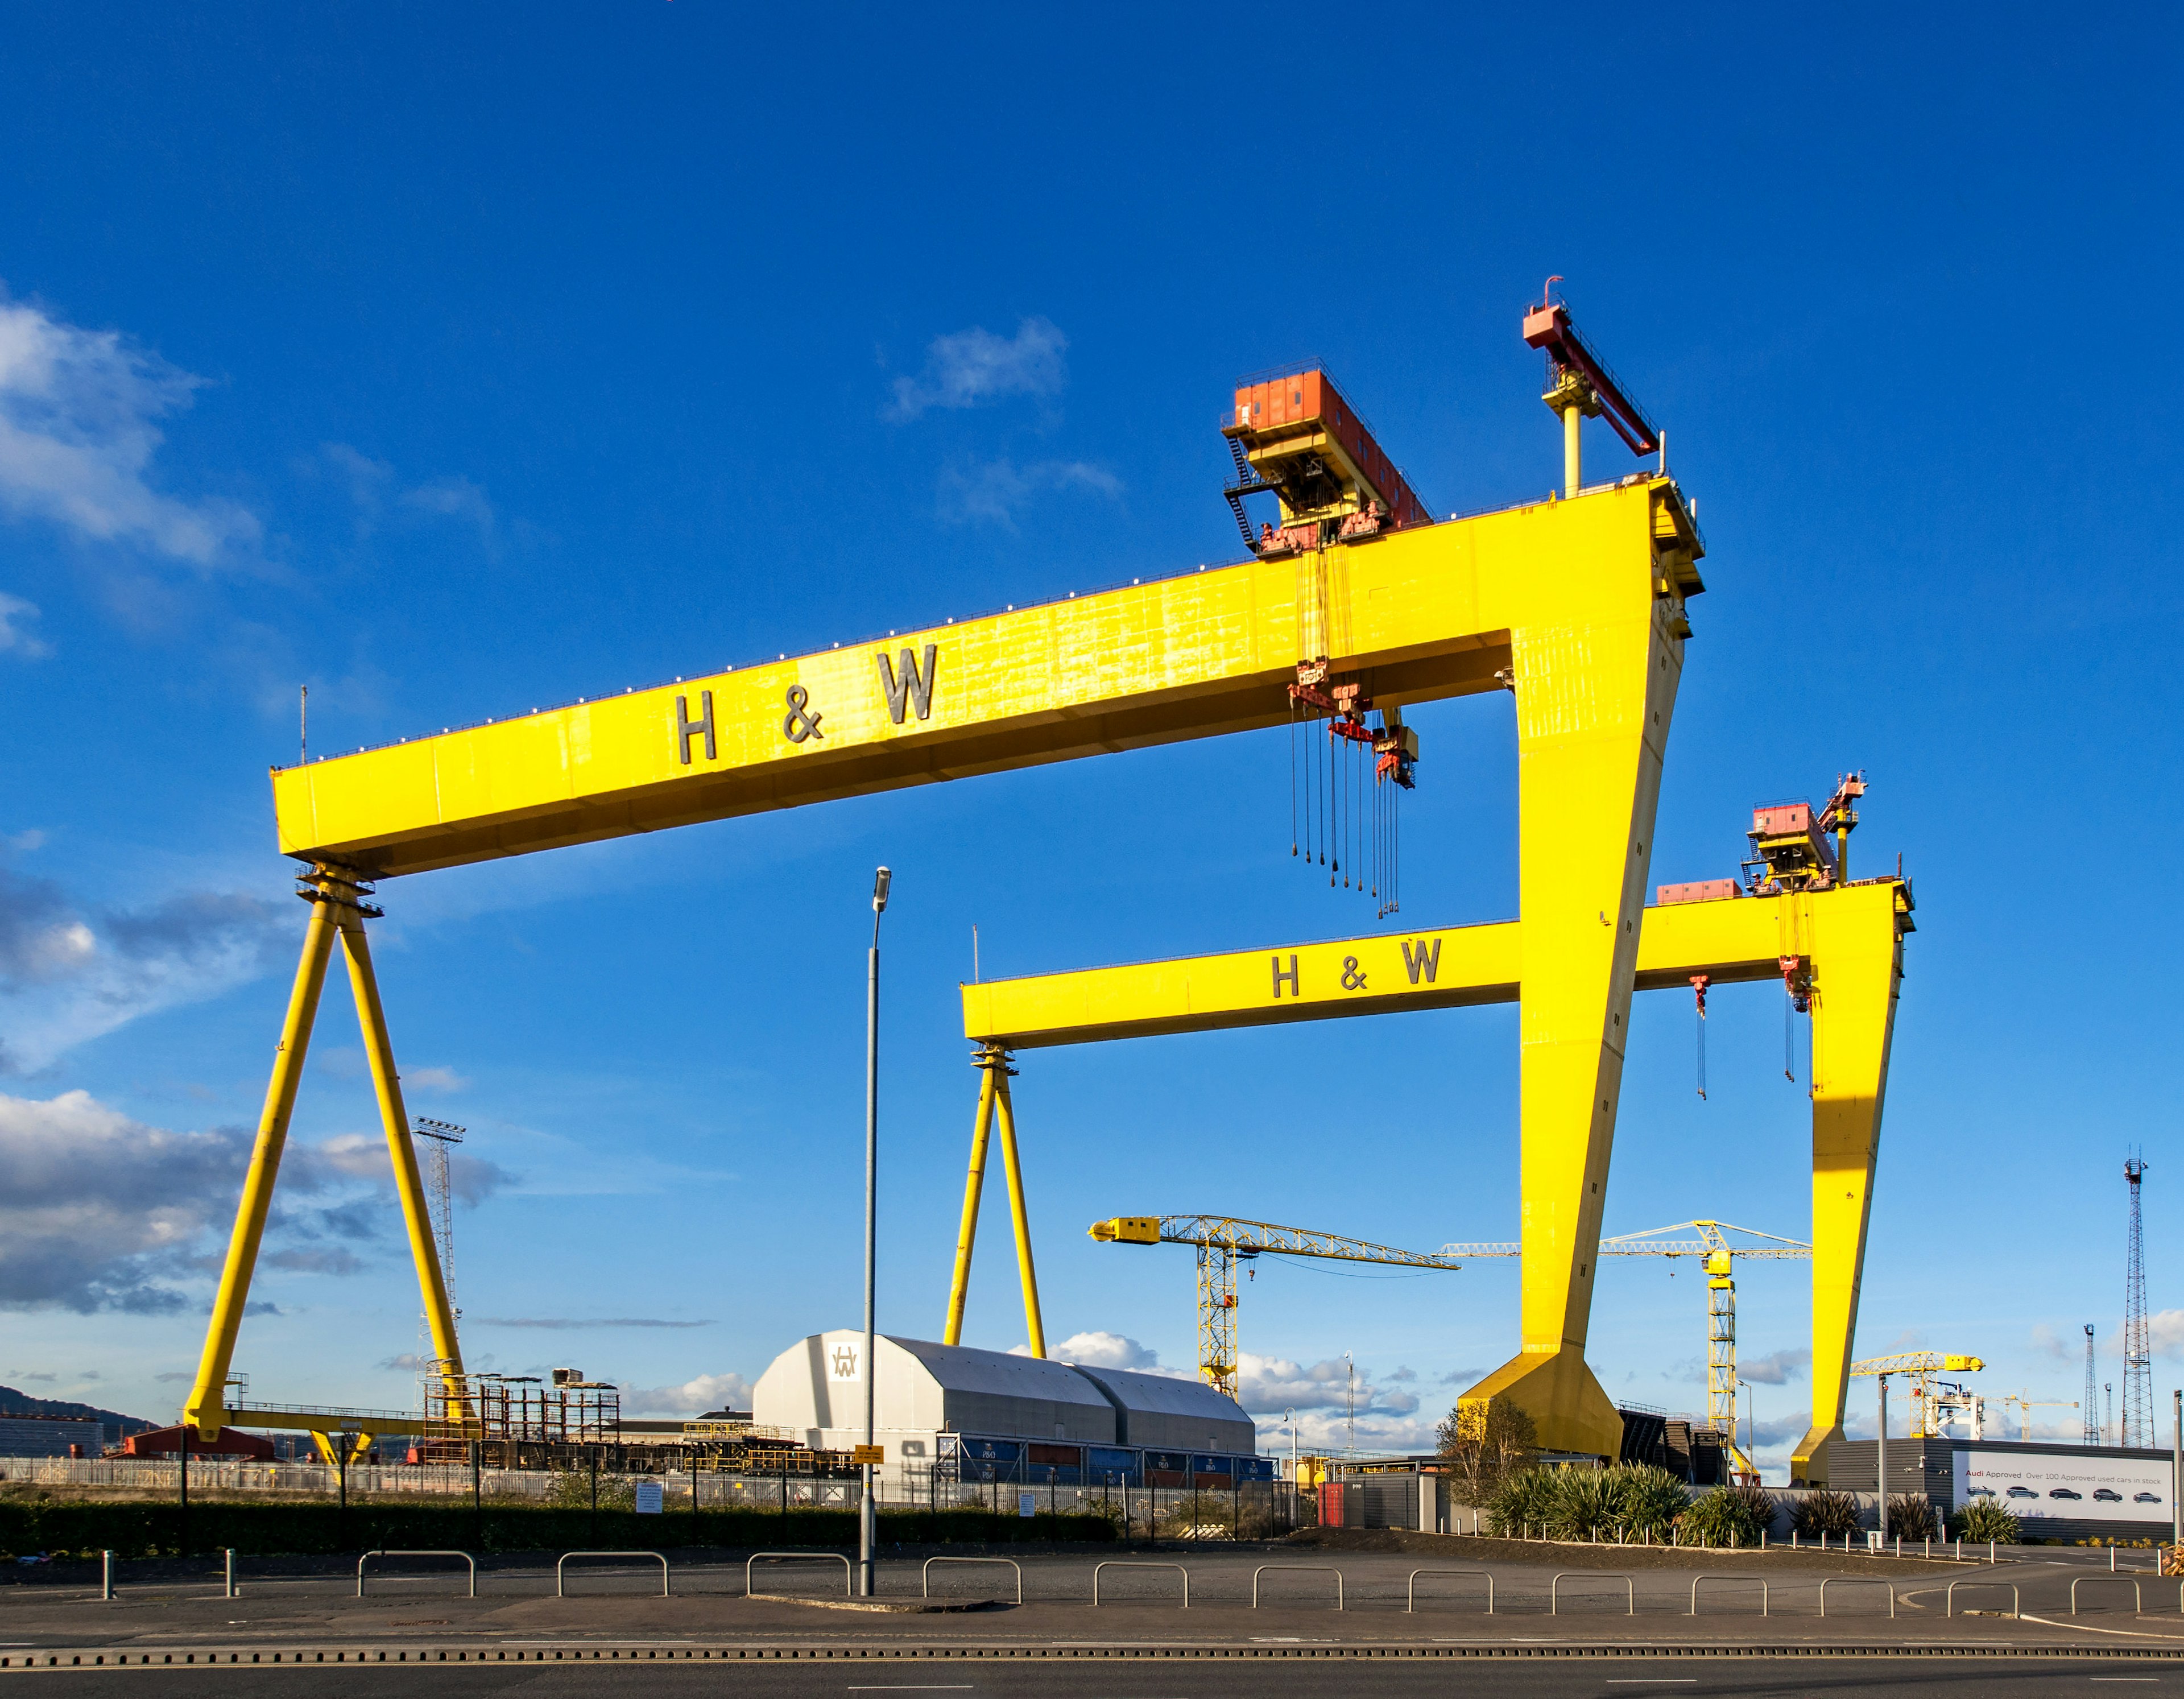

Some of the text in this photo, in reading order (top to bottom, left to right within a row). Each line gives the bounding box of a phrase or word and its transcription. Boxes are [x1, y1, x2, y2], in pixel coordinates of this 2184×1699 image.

[676, 644, 937, 764] H & W
[1272, 939, 1441, 998] H & W
[982, 1450, 995, 1459] P&O
